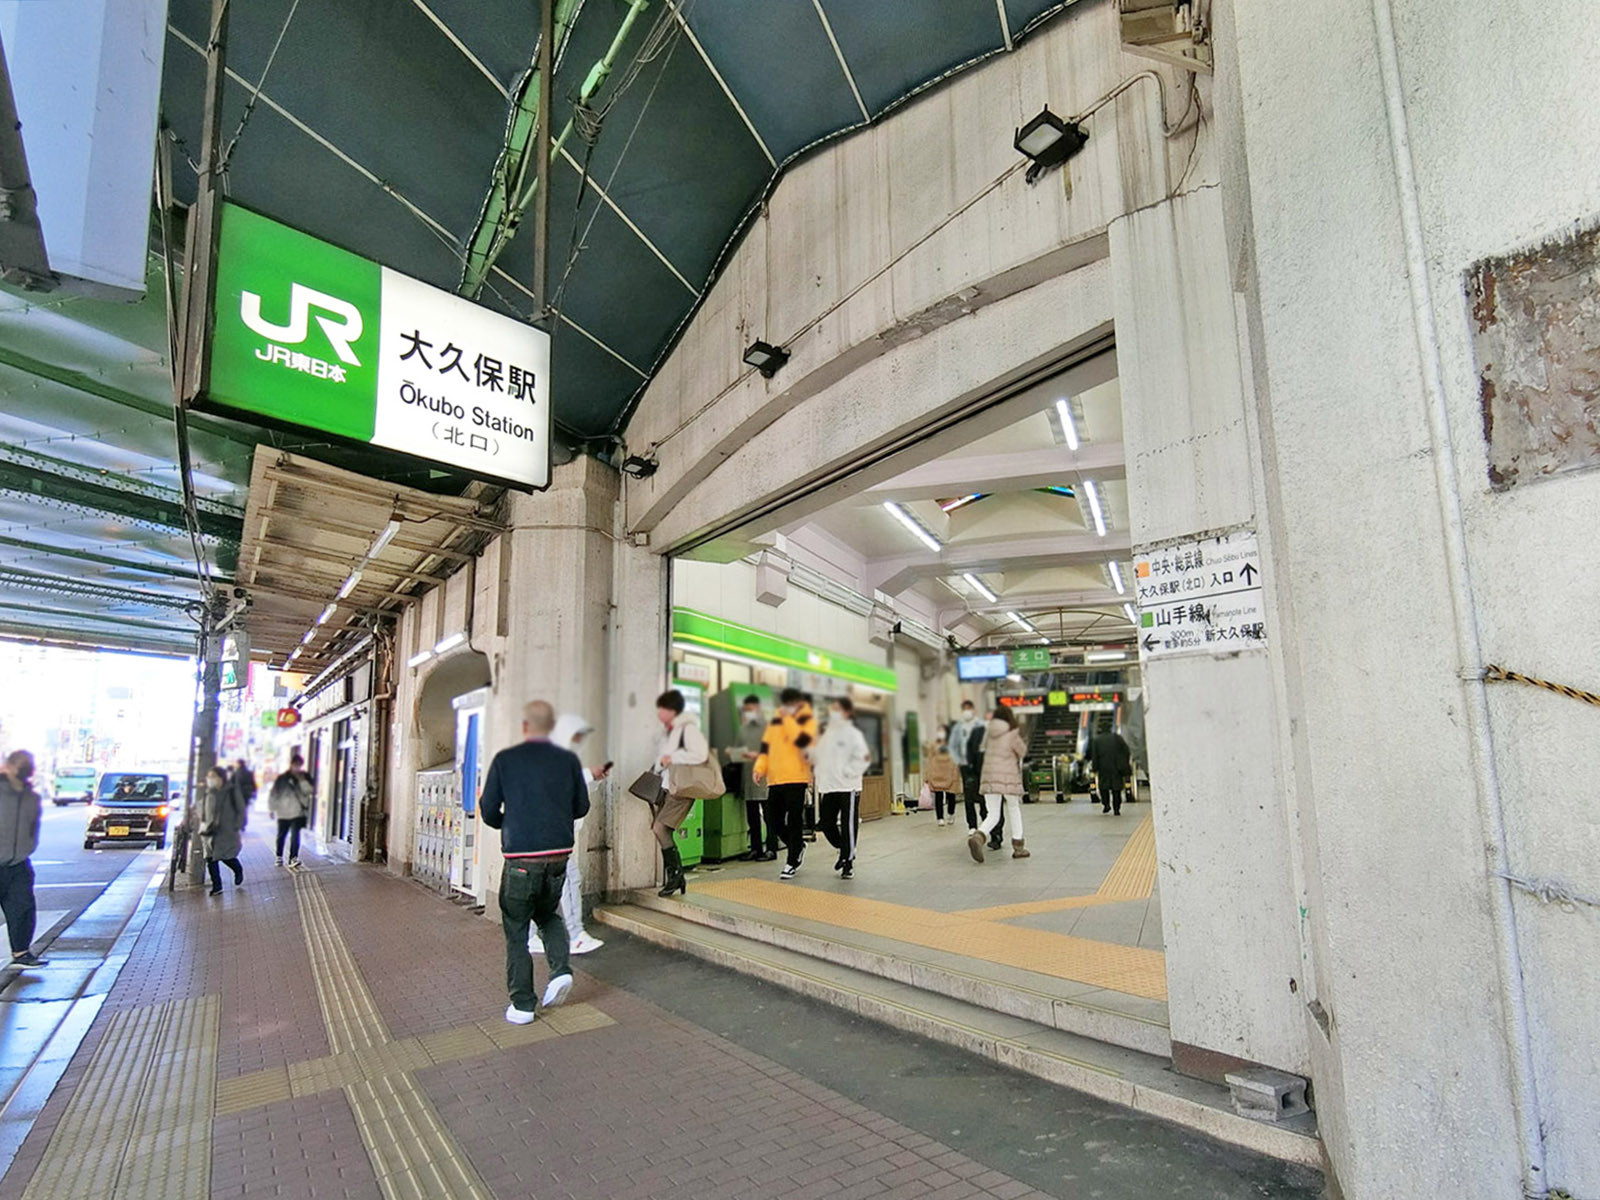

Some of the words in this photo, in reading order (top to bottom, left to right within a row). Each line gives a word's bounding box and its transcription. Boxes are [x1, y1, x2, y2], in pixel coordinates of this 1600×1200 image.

[240, 282, 363, 367] JR
[255, 343, 347, 383] JR東日本
[399, 329, 536, 405] 大久保駅
[399, 379, 465, 420] Ōkubo
[471, 406, 534, 442] Station
[1210, 571, 1233, 587] 入口
[1156, 603, 1206, 627] 山手線
[1242, 606, 1256, 615] Line
[1205, 622, 1264, 642] 新大久保駅
